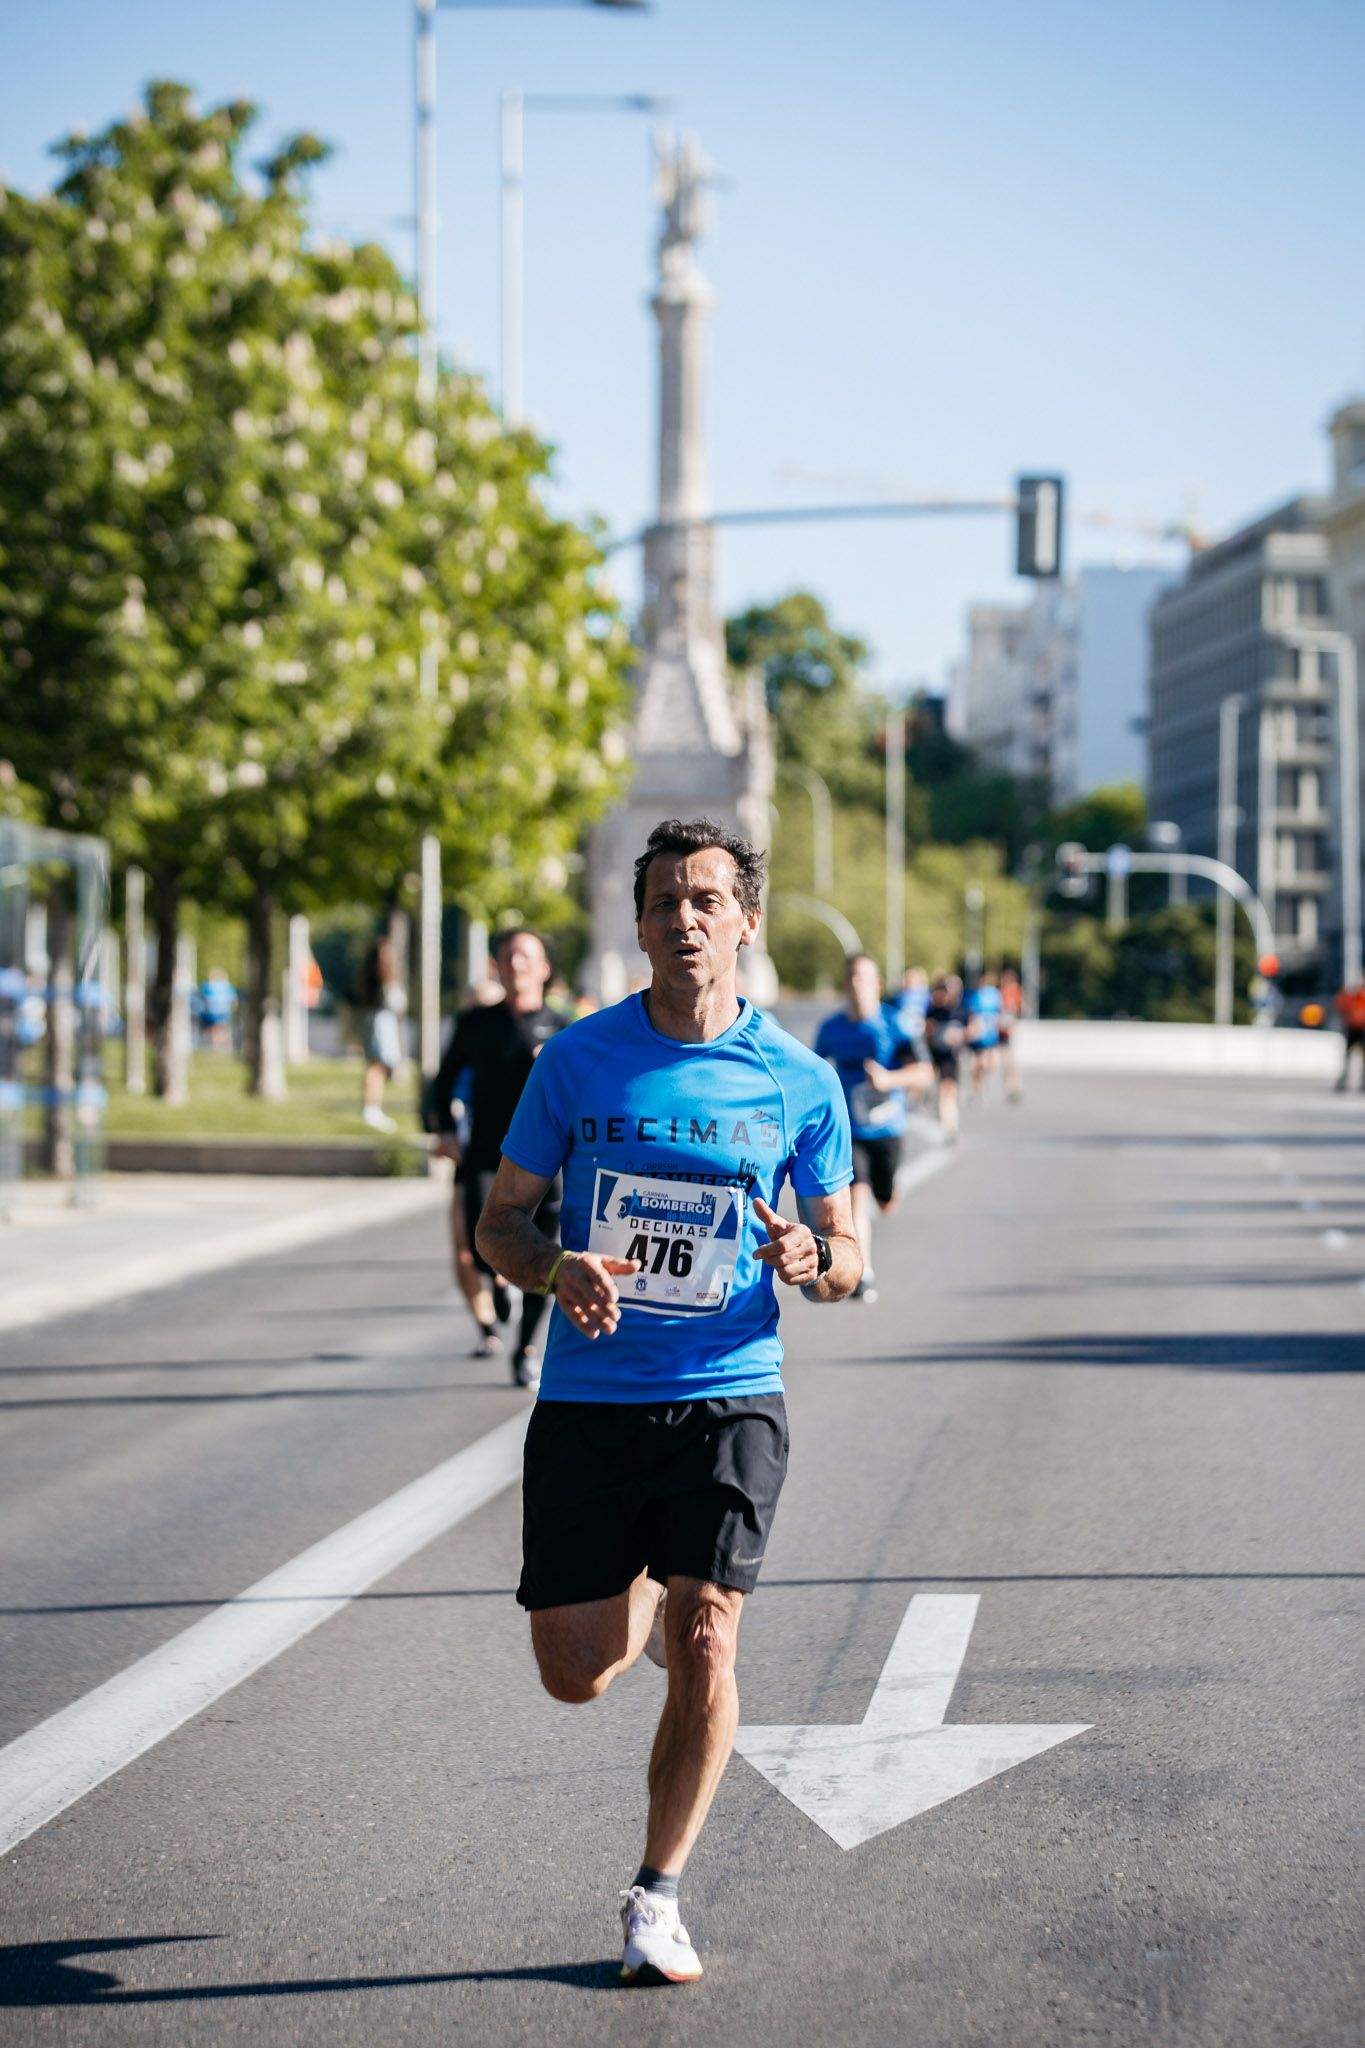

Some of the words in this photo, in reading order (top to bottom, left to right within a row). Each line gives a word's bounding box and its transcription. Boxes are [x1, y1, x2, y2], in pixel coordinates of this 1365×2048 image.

[581, 1117, 779, 1148] DECIMAS
[641, 1197, 712, 1214] BOMBEROS
[630, 1218, 708, 1237] DECIMAS
[625, 1233, 694, 1278] 476
